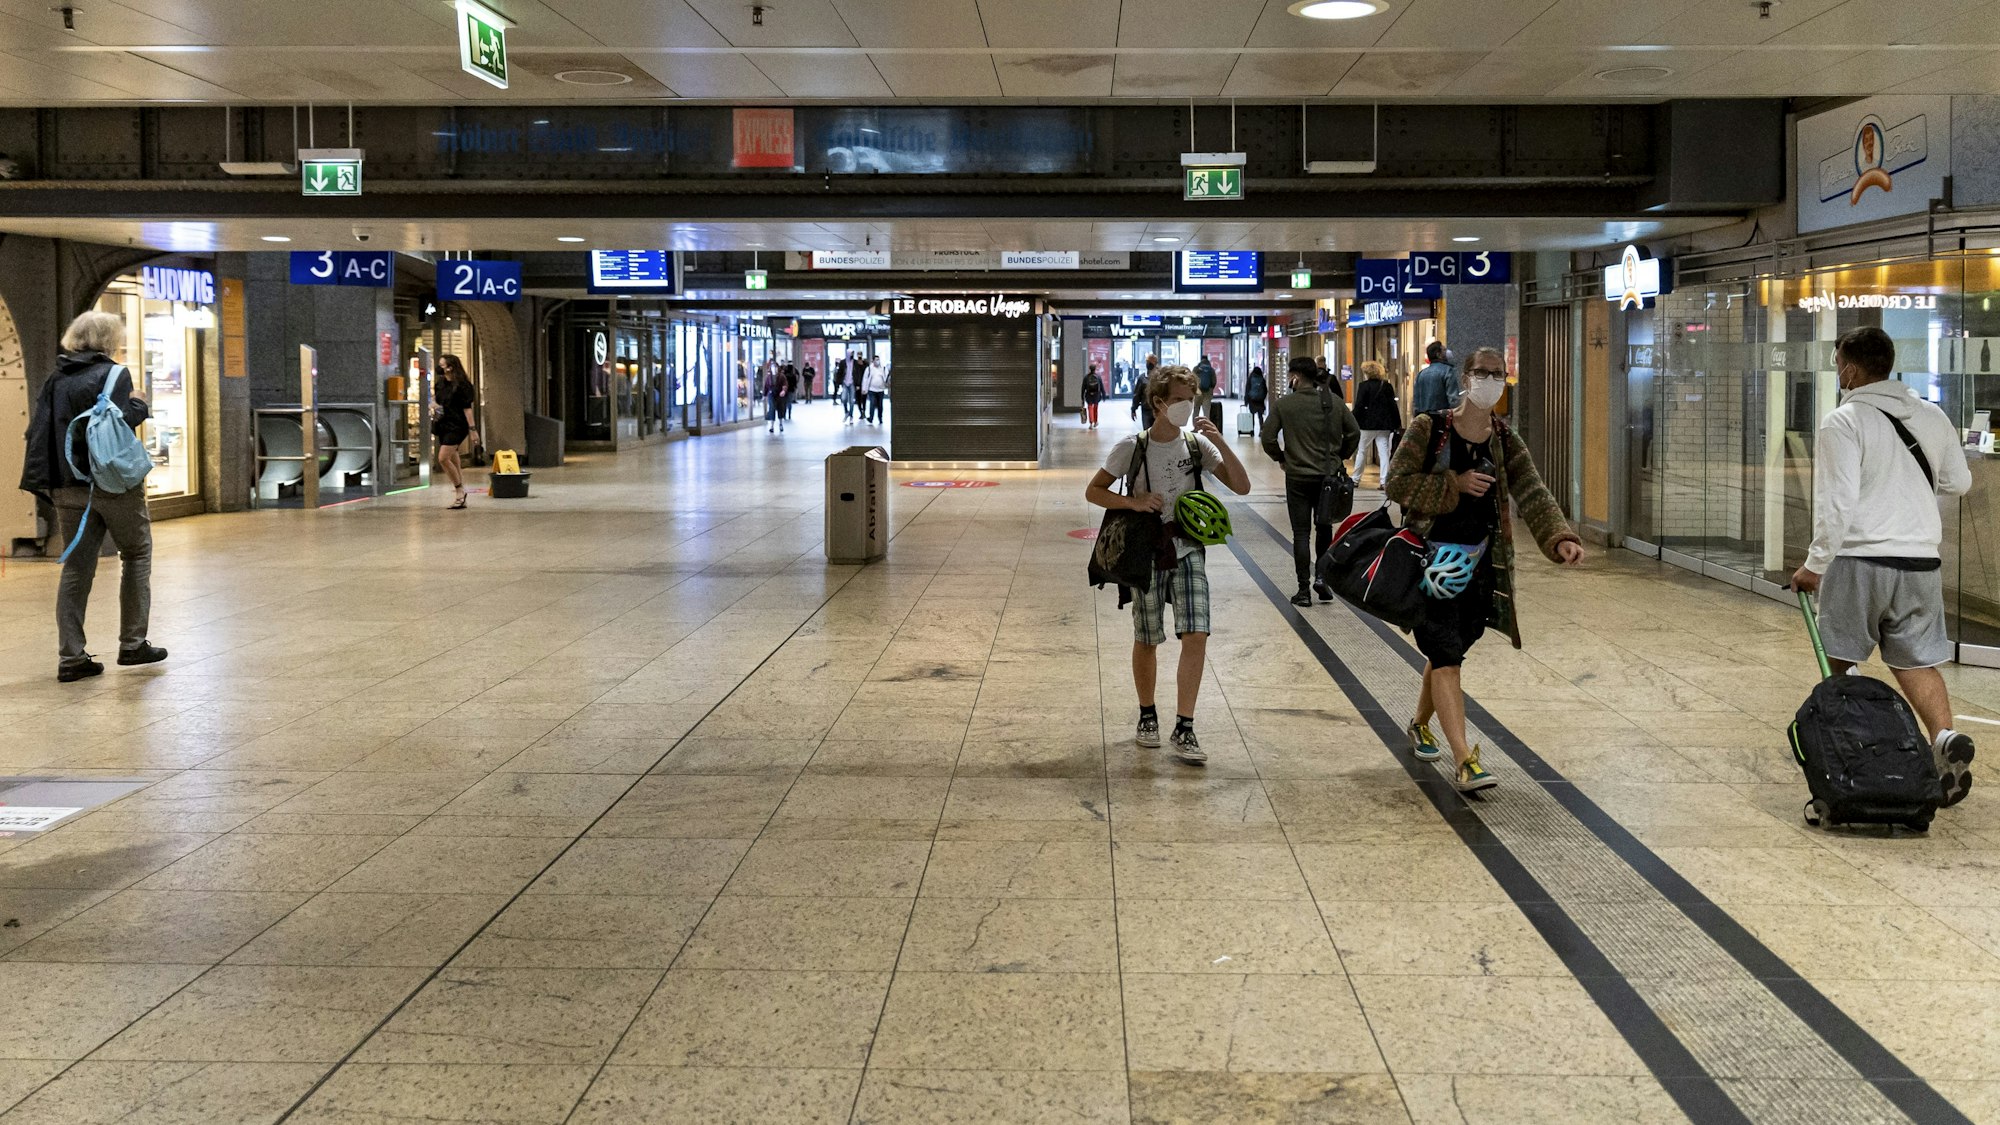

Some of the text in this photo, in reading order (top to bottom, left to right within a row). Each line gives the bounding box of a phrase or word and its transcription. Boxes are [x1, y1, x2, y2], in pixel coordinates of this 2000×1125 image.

[734, 118, 793, 154] EXPRESS
[310, 251, 334, 278] 3
[345, 258, 386, 279] A-C
[819, 256, 885, 265] BUNDESPOLIZEI
[1007, 256, 1073, 265] BUNDESPOLIZEI
[1080, 257, 1121, 265] shotel.com
[1414, 256, 1456, 277] D-G
[1467, 251, 1491, 277] 3
[142, 266, 215, 304] LUDWIG
[454, 264, 474, 295] 2
[483, 276, 517, 296] A-C
[1360, 276, 1396, 293] D-G
[893, 294, 1030, 318] LE CROBAG Veggie
[739, 323, 772, 338] ETERNA
[821, 323, 856, 336] WDR
[868, 484, 877, 541] Abfall
